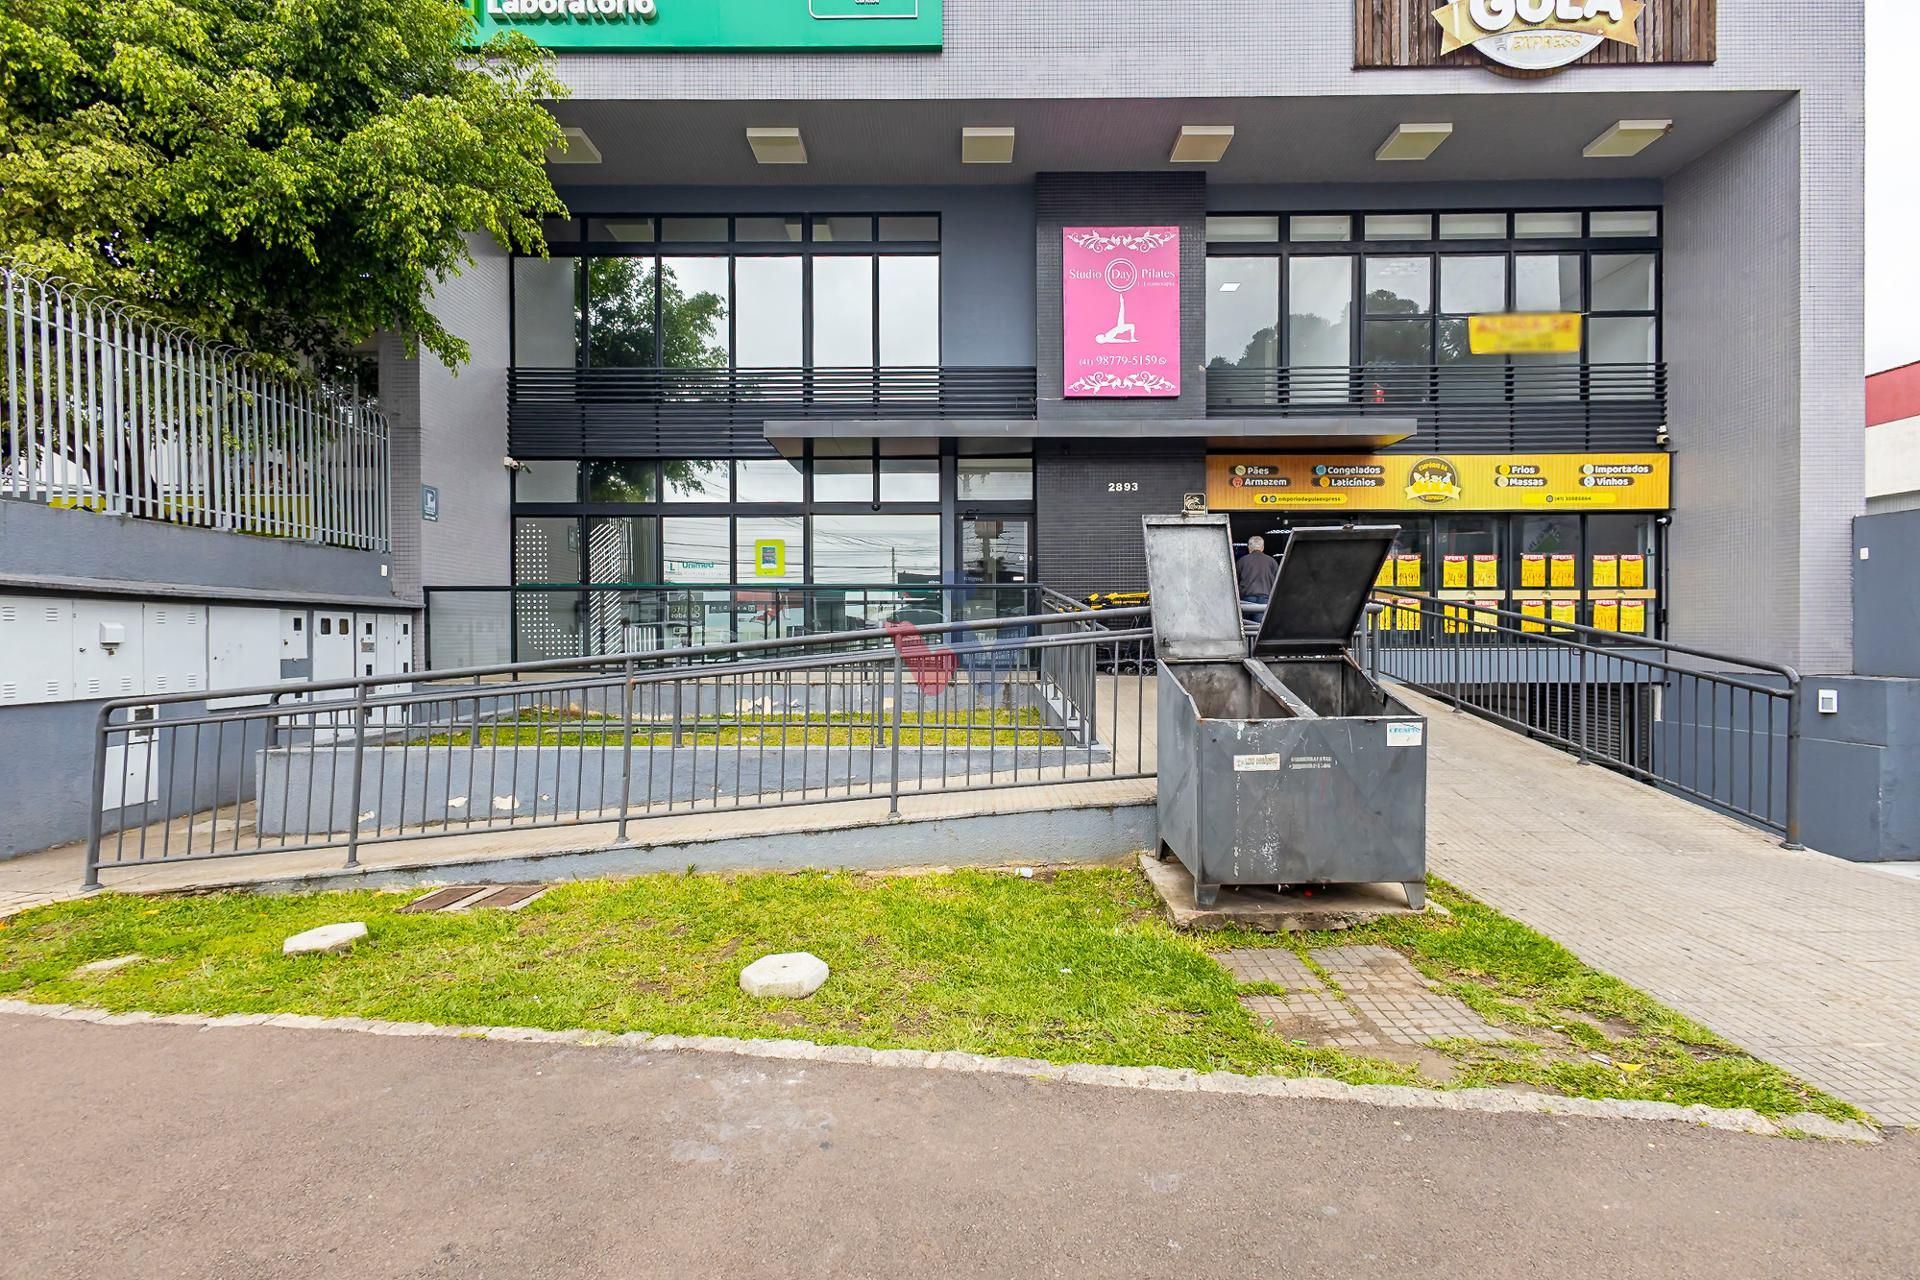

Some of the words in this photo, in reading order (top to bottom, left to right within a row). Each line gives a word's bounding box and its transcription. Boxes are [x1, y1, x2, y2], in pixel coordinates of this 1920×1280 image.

[1069, 268, 1102, 280] Studio
[1111, 269, 1132, 281] Day
[1141, 269, 1176, 280] Pilates
[1096, 355, 1158, 366] 98779-5159
[1247, 465, 1270, 475] Pães
[1327, 466, 1381, 477] Congelados
[1511, 465, 1536, 475] Frios
[1595, 464, 1650, 475] Importados
[1509, 477, 1545, 487] Massas
[1595, 476, 1630, 486] Vinhos
[1108, 482, 1139, 492] 2893
